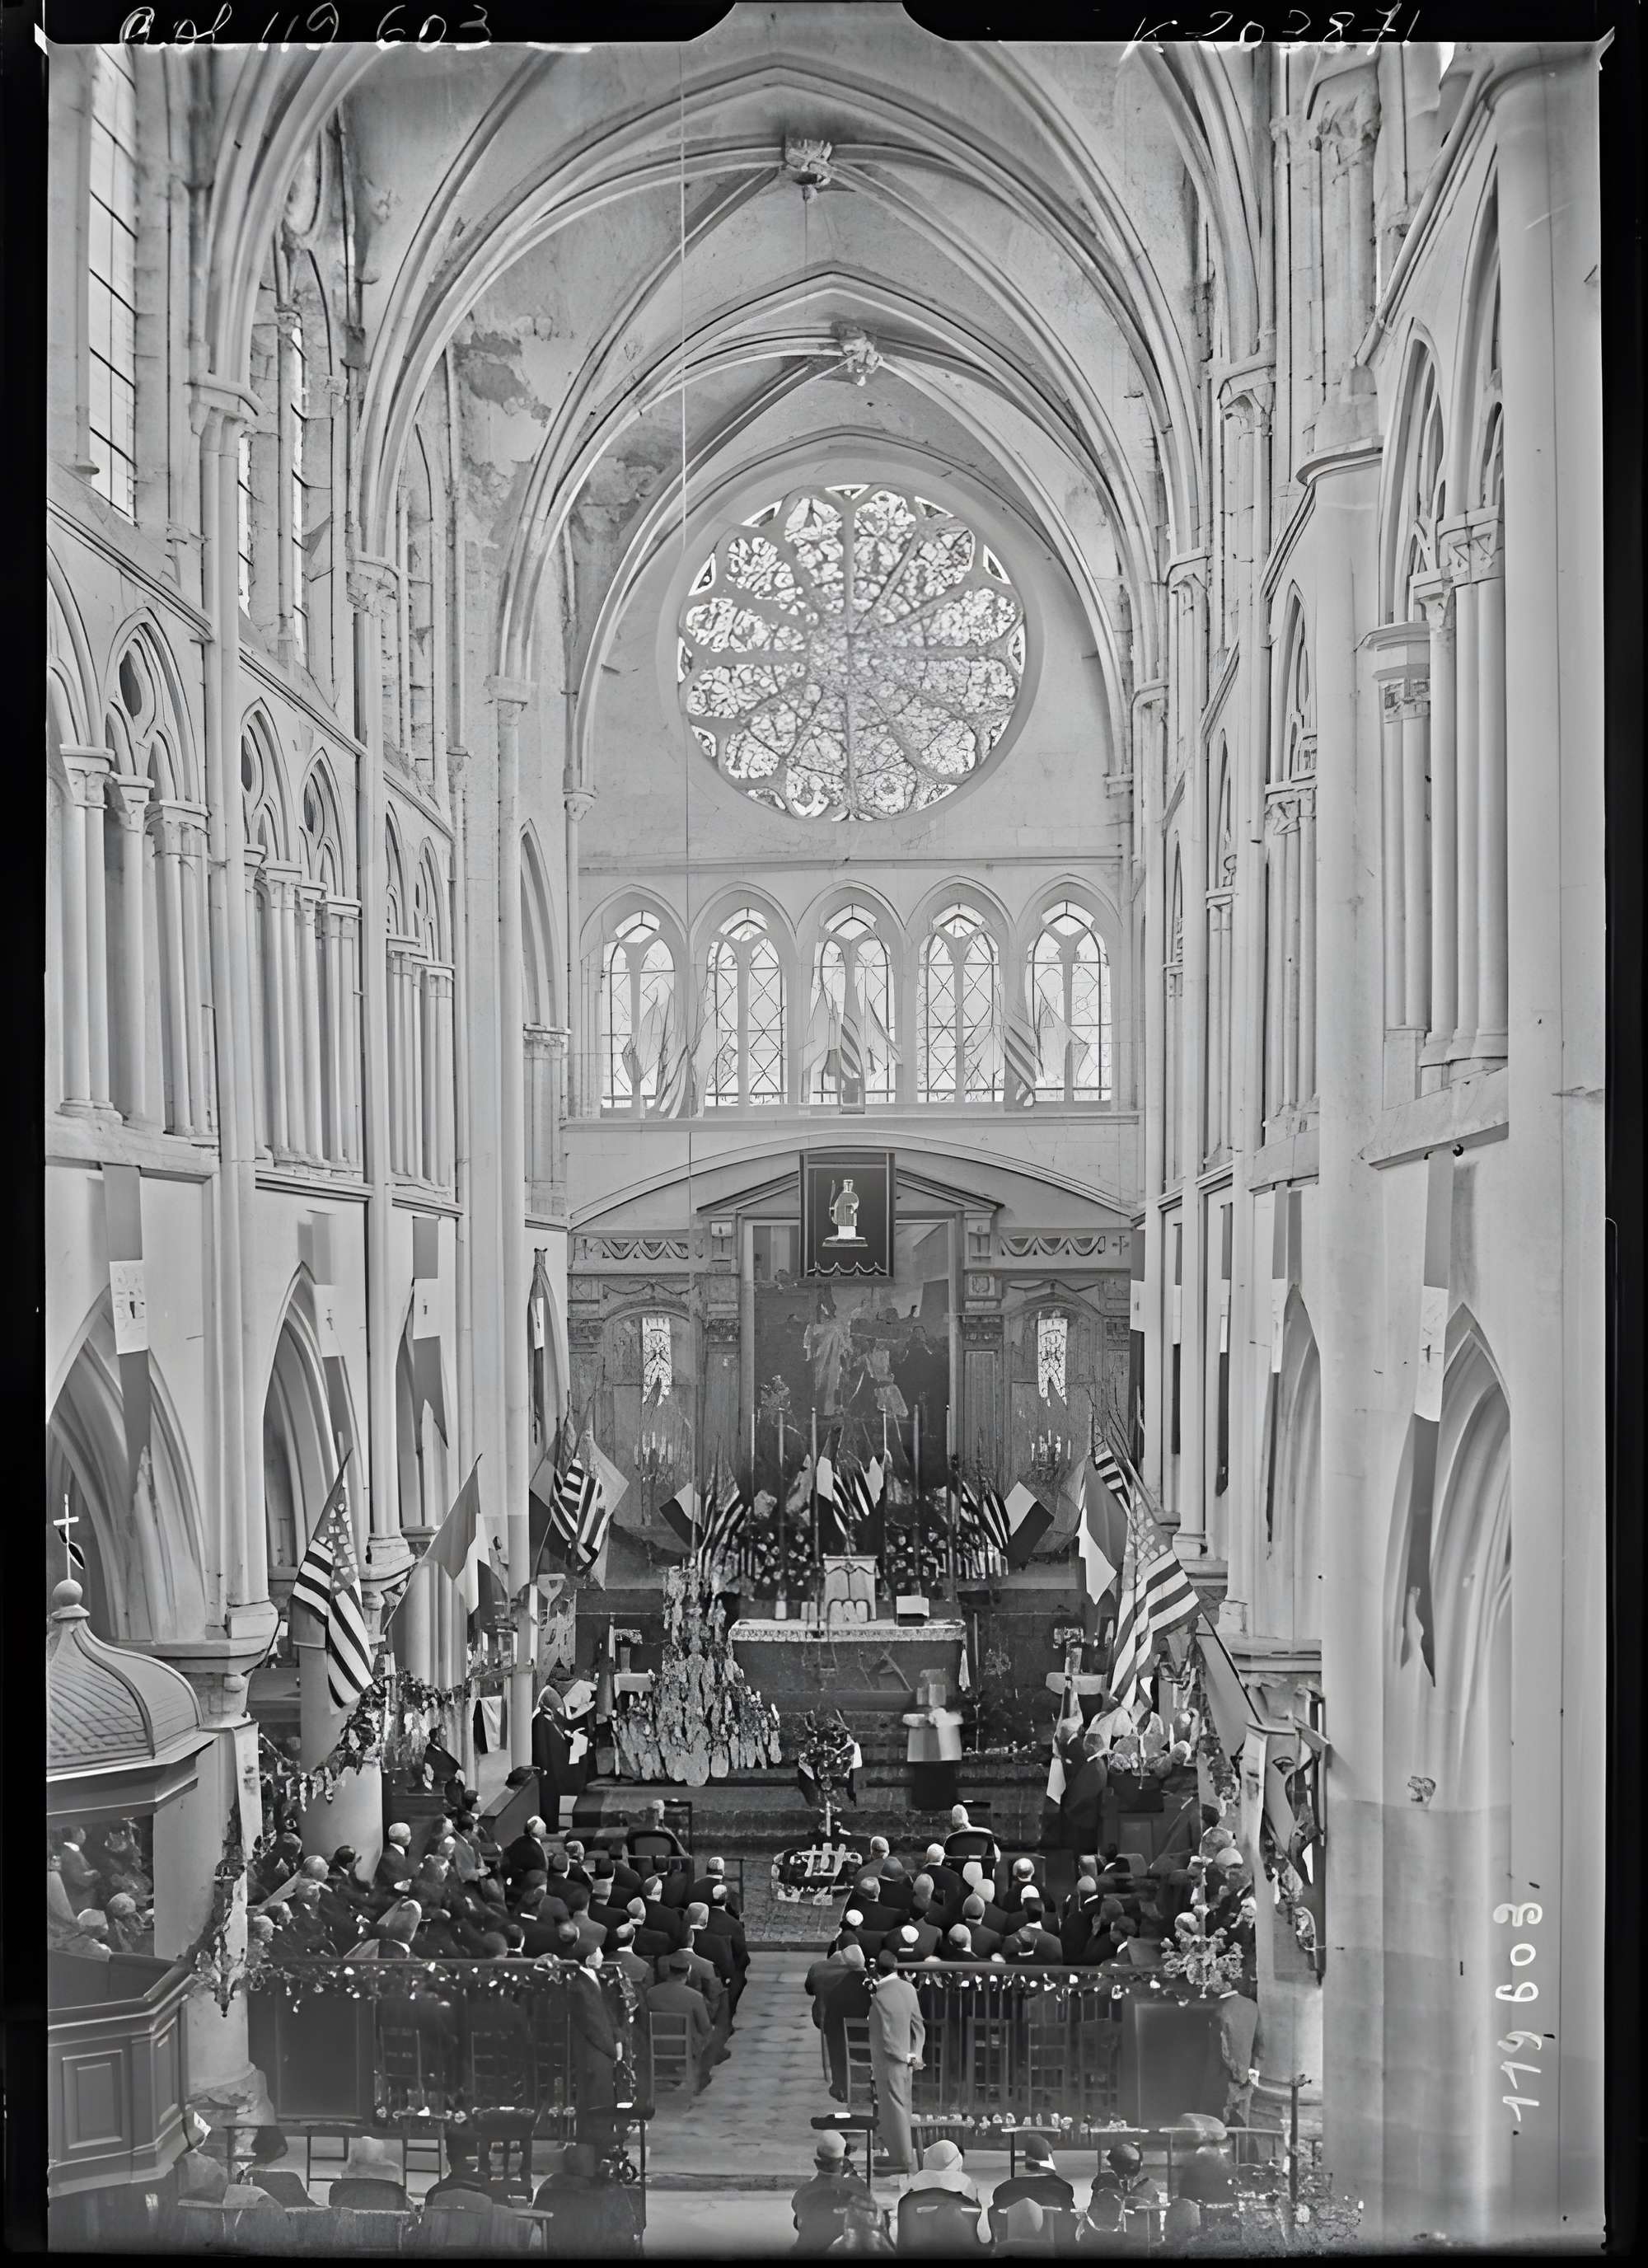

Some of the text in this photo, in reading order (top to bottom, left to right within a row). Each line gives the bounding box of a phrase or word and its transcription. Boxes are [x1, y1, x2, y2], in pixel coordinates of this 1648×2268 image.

[258, 2, 339, 52] 119
[376, 4, 493, 51] 603
[1493, 1902, 1543, 2122] 119 603
